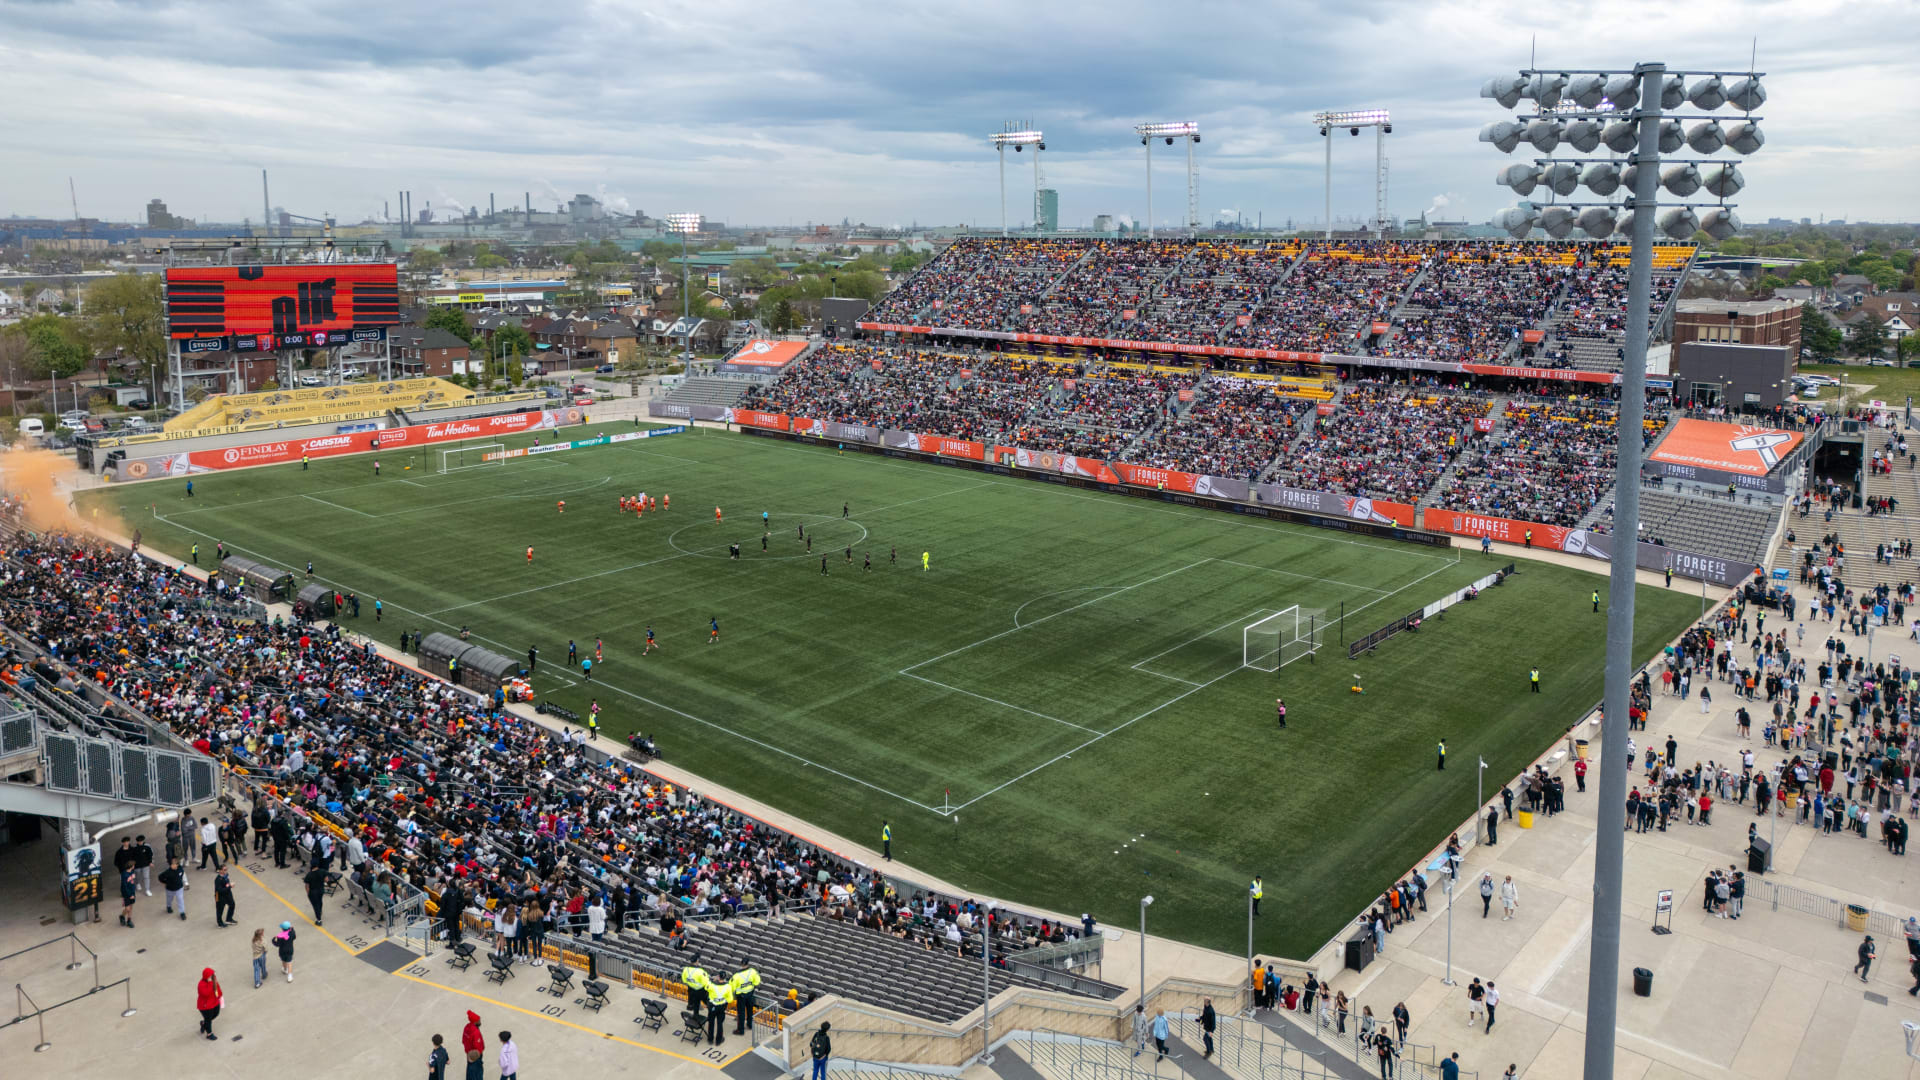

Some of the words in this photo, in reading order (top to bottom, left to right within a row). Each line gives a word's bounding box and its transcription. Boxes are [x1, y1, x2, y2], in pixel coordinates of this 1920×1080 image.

[192, 341, 218, 349] STELCO
[285, 336, 302, 344] 0:00
[1502, 368, 1537, 377] TOGETHER
[1541, 370, 1550, 378] WE
[1554, 370, 1576, 380] FORGE
[318, 414, 340, 422] STELCO
[345, 412, 364, 420] NORTH
[490, 414, 527, 426] JOURNIE
[166, 430, 192, 440] STELCO
[198, 428, 220, 436] NORTH
[382, 432, 403, 440] STELCO
[426, 425, 444, 438] Tim
[444, 424, 480, 436] Hortons
[651, 428, 676, 436] Volkswagen
[310, 436, 350, 448] CARSTAR
[946, 440, 964, 450] FORGE
[240, 443, 288, 456] FINDLAY
[528, 444, 570, 453] WeatherTech
[1657, 452, 1760, 472] WeatherTech
[1138, 468, 1160, 481] FORGE
[1162, 472, 1168, 480] FC
[1668, 464, 1688, 474] FORGE
[1738, 476, 1760, 486] FORGE
[1283, 490, 1311, 504] FORGE
[1312, 494, 1320, 502] FC
[1244, 507, 1268, 516] ULTIMATE
[1322, 519, 1348, 529] ULTIMATE
[1465, 517, 1498, 532] FORGE
[1500, 522, 1508, 530] FC
[1406, 533, 1434, 542] ULTIMATE
[1676, 554, 1714, 572] FORGE
[1716, 562, 1726, 572] FC
[1676, 566, 1726, 582] HAMILTON
[246, 862, 266, 874] 102
[74, 878, 98, 904] 21
[345, 934, 368, 949] 102
[406, 964, 430, 978] 101
[540, 1004, 566, 1018] 101
[702, 1047, 728, 1064] 101
